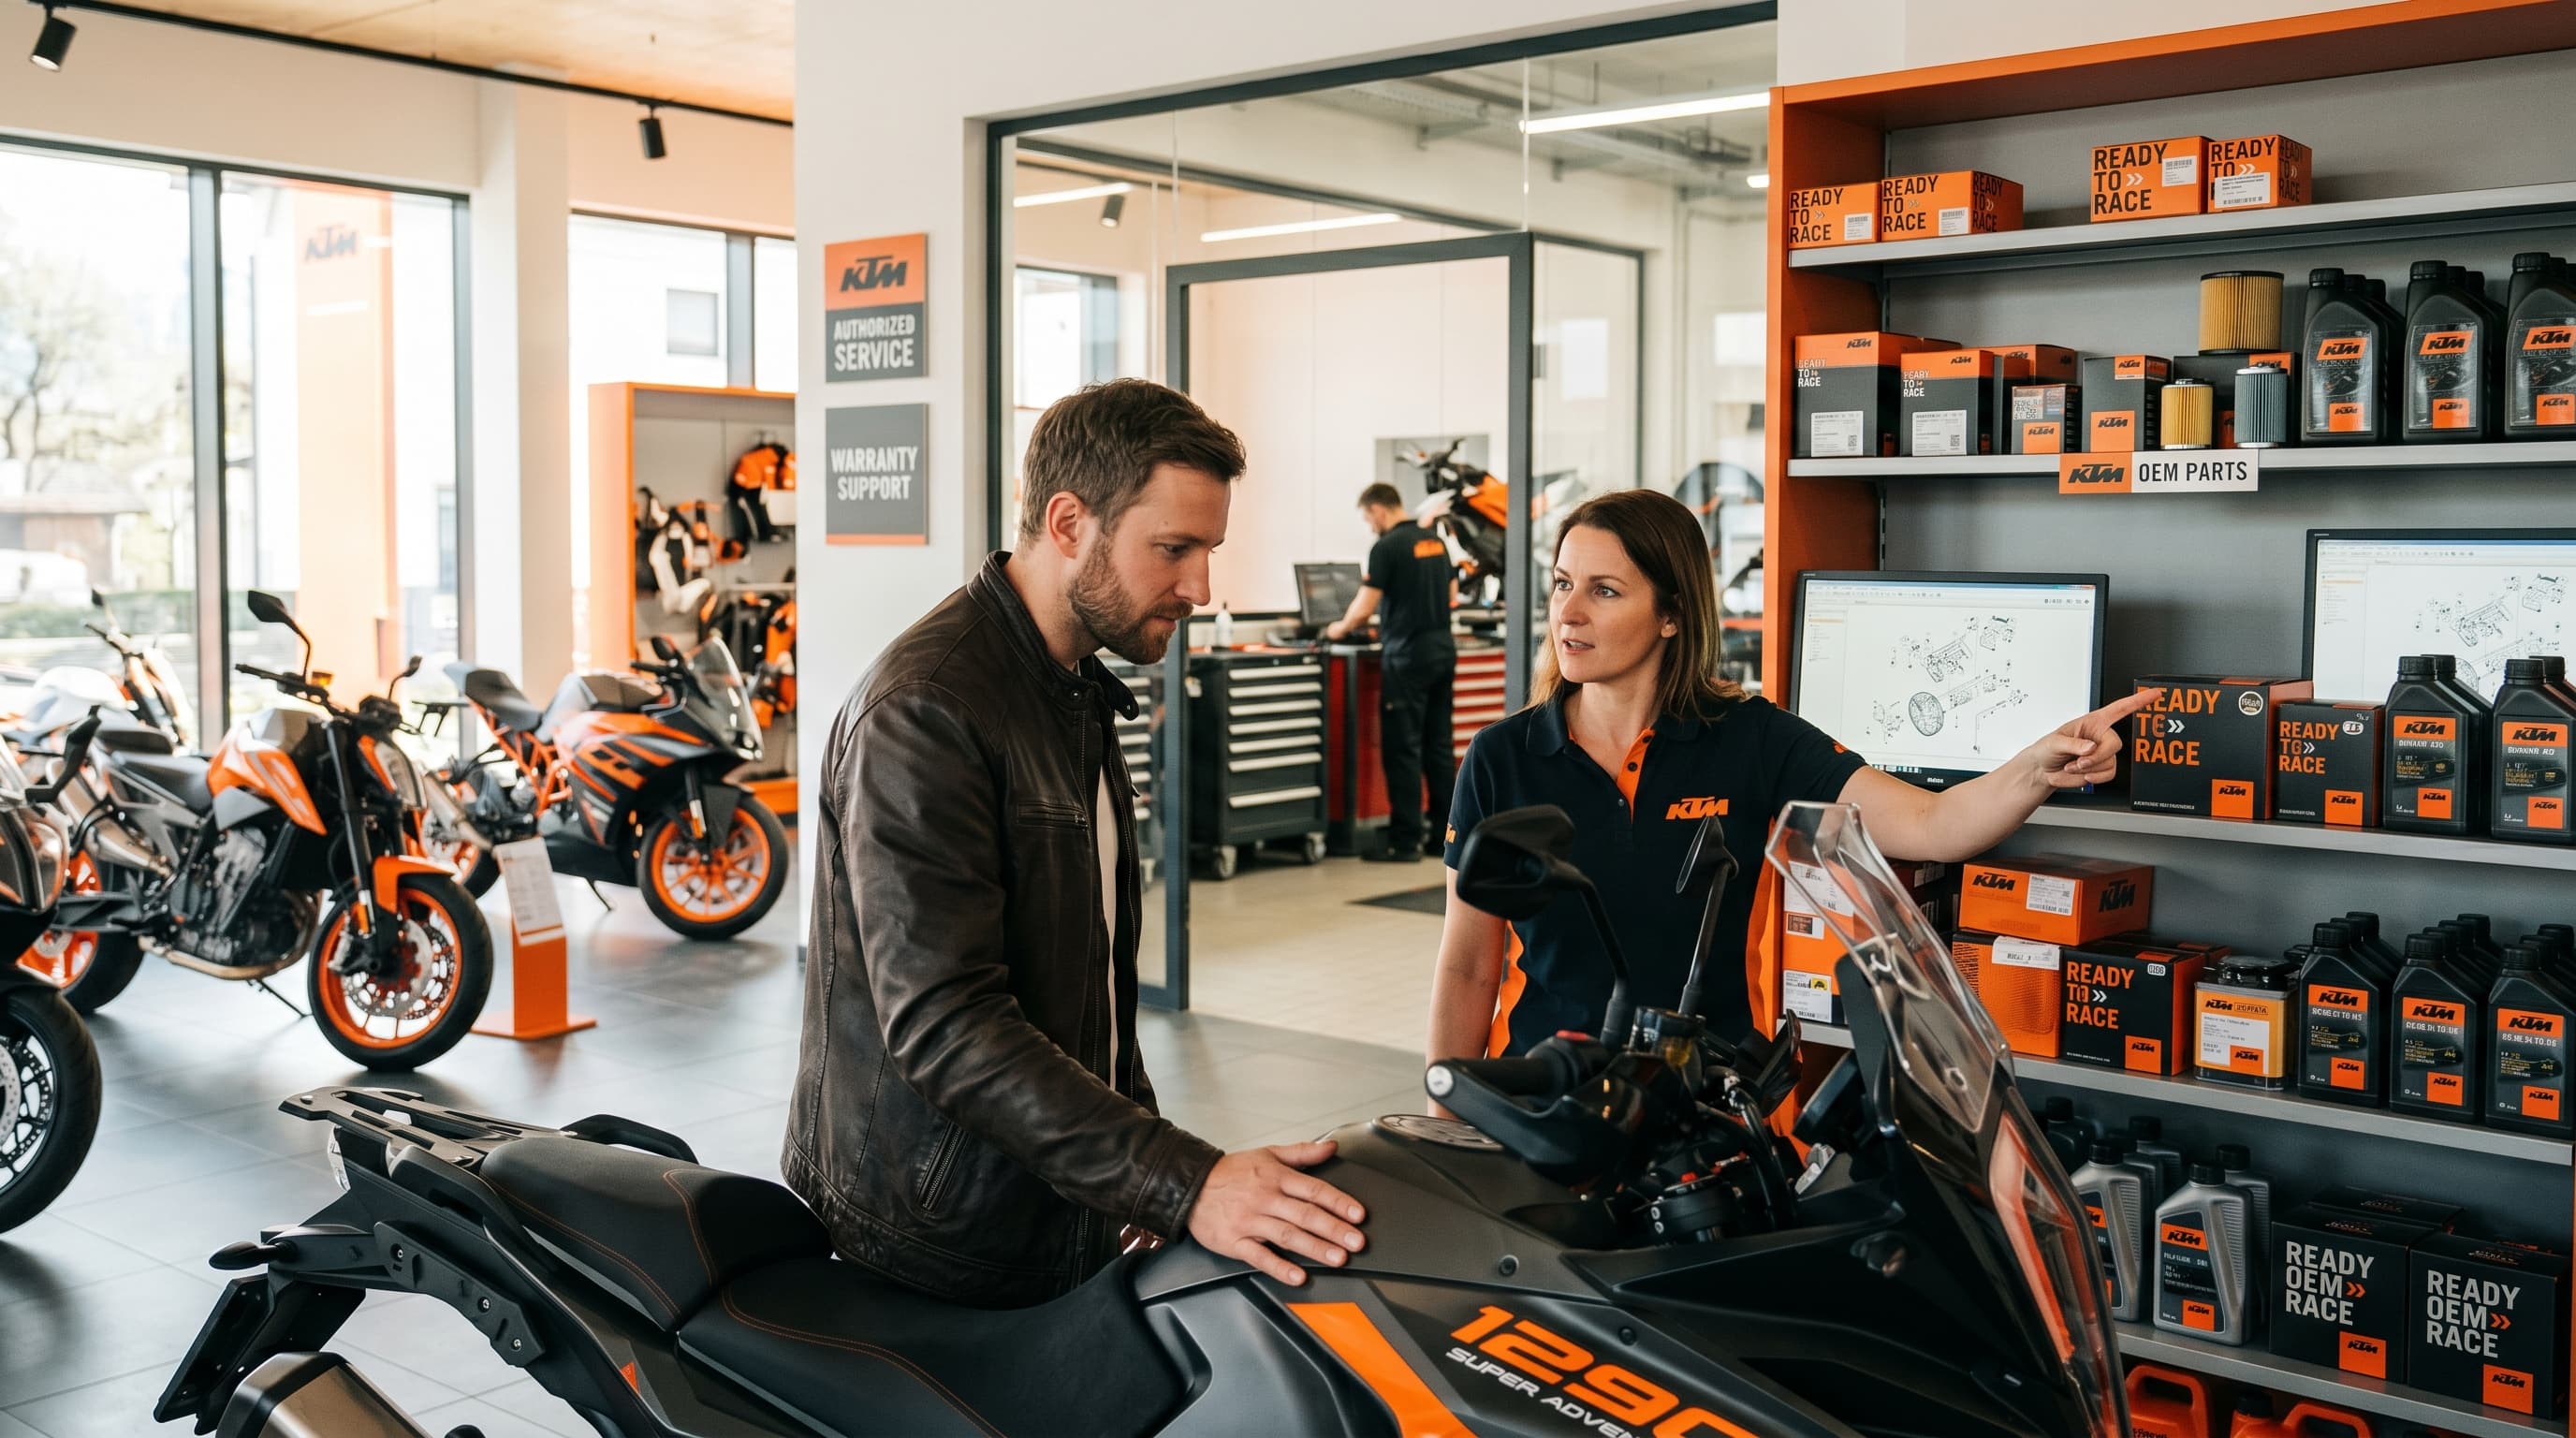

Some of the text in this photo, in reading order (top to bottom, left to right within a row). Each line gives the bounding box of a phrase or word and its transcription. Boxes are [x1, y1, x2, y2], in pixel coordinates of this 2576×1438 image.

[2094, 143, 2168, 170] READY
[2211, 137, 2276, 162] READY
[2211, 161, 2235, 179] TO
[1883, 175, 1939, 198] READY
[1973, 173, 2003, 197] READY
[2094, 169, 2122, 193] TO
[1790, 188, 1843, 209] READY
[1883, 198, 1904, 213] TO
[1973, 192, 1985, 211] TO
[2094, 189, 2152, 215] RACE
[1790, 209, 1809, 226] TO
[1883, 213, 1926, 233] RACE
[1973, 210, 1997, 232] RACE
[304, 223, 359, 262] KTM
[1790, 225, 1832, 243] RACE
[840, 255, 908, 292] KTM
[834, 314, 915, 341] AUTHORIZED
[2427, 336, 2465, 350] KTM
[2531, 330, 2571, 345] KTM
[834, 338, 915, 372] SERVICE
[2323, 343, 2360, 356] KTM
[1798, 369, 1809, 377] TO
[2118, 360, 2141, 369] KTM
[1798, 377, 1821, 388] RACE
[1903, 379, 1915, 389] TO
[1903, 388, 1925, 398] RACE
[2098, 417, 2129, 428] KTM
[830, 447, 918, 473] WARRANTY
[2067, 461, 2247, 484] KTM OEM PARTS
[838, 475, 912, 501] SUPPORT
[2279, 721, 2340, 741] READY
[2404, 721, 2445, 735] KTM
[2512, 727, 2557, 741] KTM
[2135, 738, 2200, 766] RACE
[2279, 756, 2326, 774] RACE
[2218, 785, 2247, 796] KTM
[2331, 795, 2356, 805] KTM
[1665, 797, 1729, 820] KTM
[1972, 873, 2016, 891] KTM
[2099, 880, 2136, 913] KTM
[2066, 961, 2134, 990] READY
[2205, 999, 2232, 1011] KTM
[2318, 990, 2359, 1006] KTM
[2066, 1005, 2119, 1030] RACE
[2412, 1004, 2454, 1020] KTM
[2509, 1015, 2554, 1032] KTM
[2131, 1041, 2155, 1053] KTM
[2529, 1091, 2554, 1101] KTM
[2167, 1230, 2202, 1245] KTM
[2286, 1240, 2374, 1280] READY
[2286, 1266, 2342, 1299] OEM
[2427, 1269, 2521, 1311] READY
[2286, 1288, 2354, 1327] RACE
[2427, 1296, 2487, 1330] OEM
[2347, 1338, 2378, 1355] KTM
[2426, 1318, 2498, 1358] RACE
[1445, 1347, 1541, 1397] SUPER
[2492, 1372, 2525, 1389] KTM
